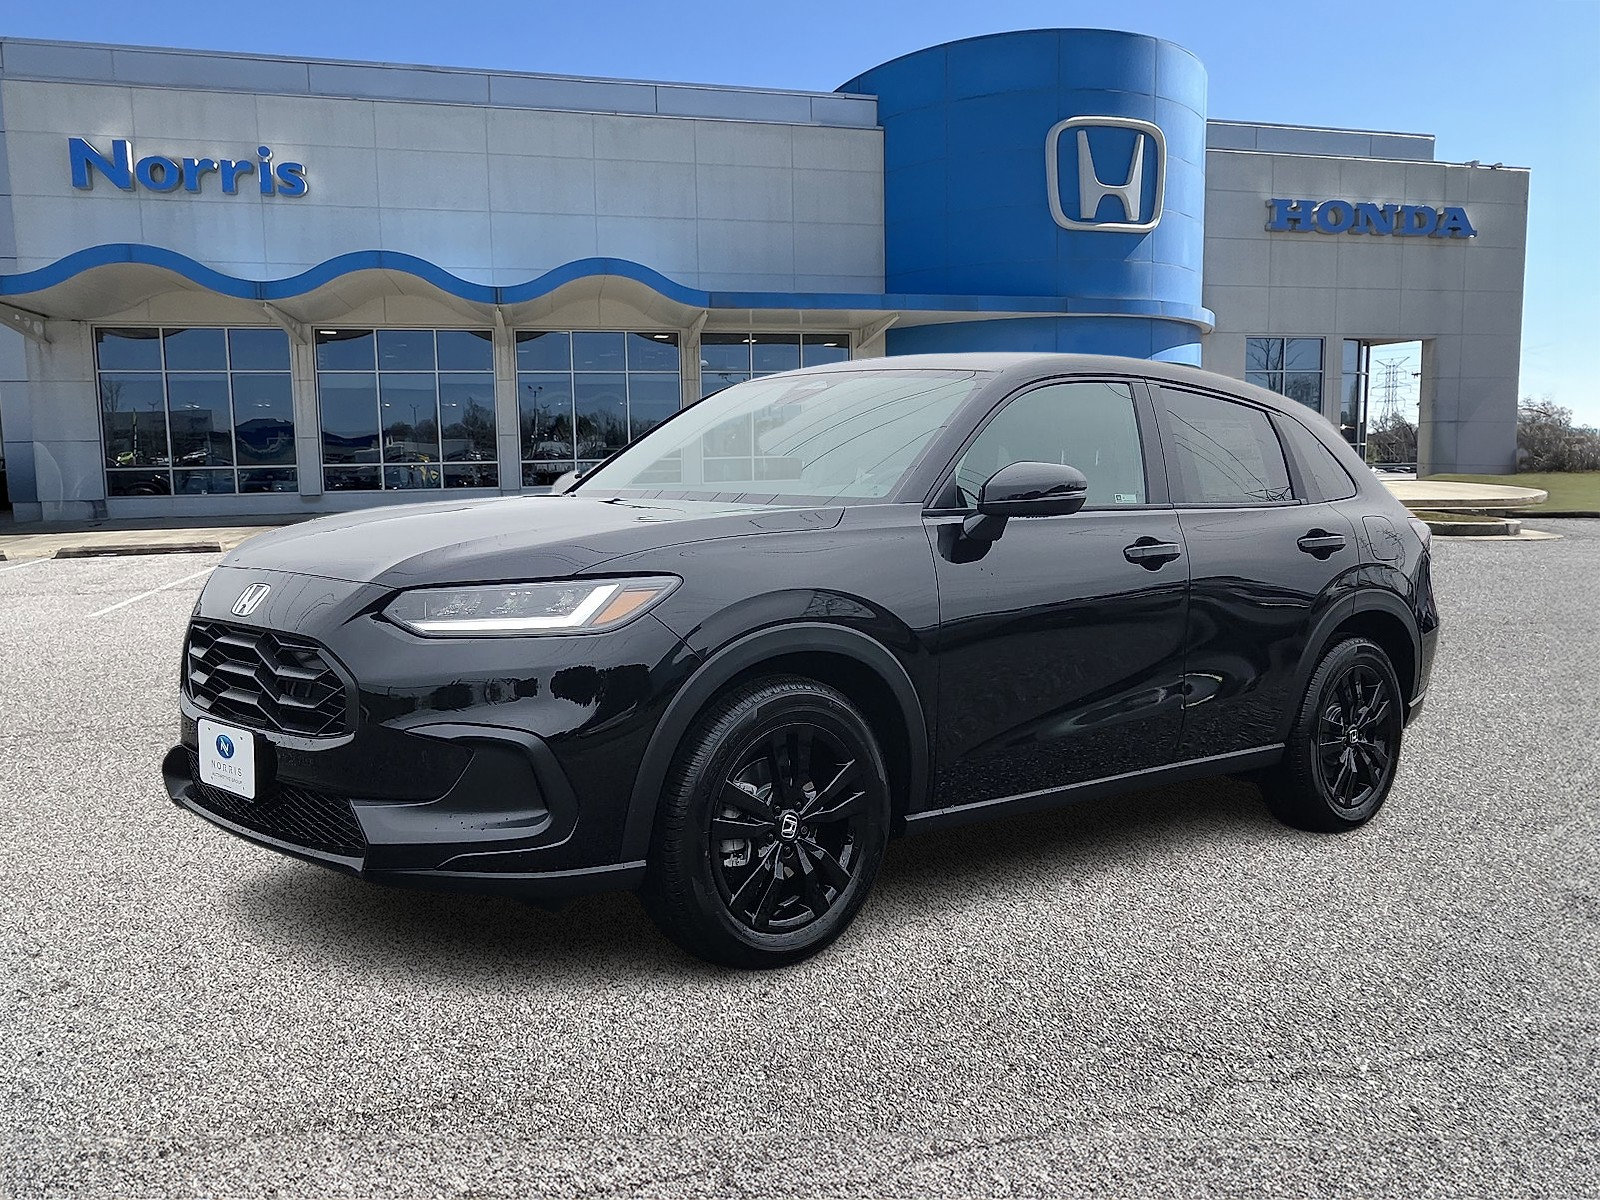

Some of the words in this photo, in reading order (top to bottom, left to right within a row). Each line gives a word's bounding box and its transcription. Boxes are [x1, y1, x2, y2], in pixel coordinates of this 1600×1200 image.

[68, 137, 309, 197] Norris
[1265, 198, 1478, 239] HONDA
[211, 759, 243, 777] NORRIS
